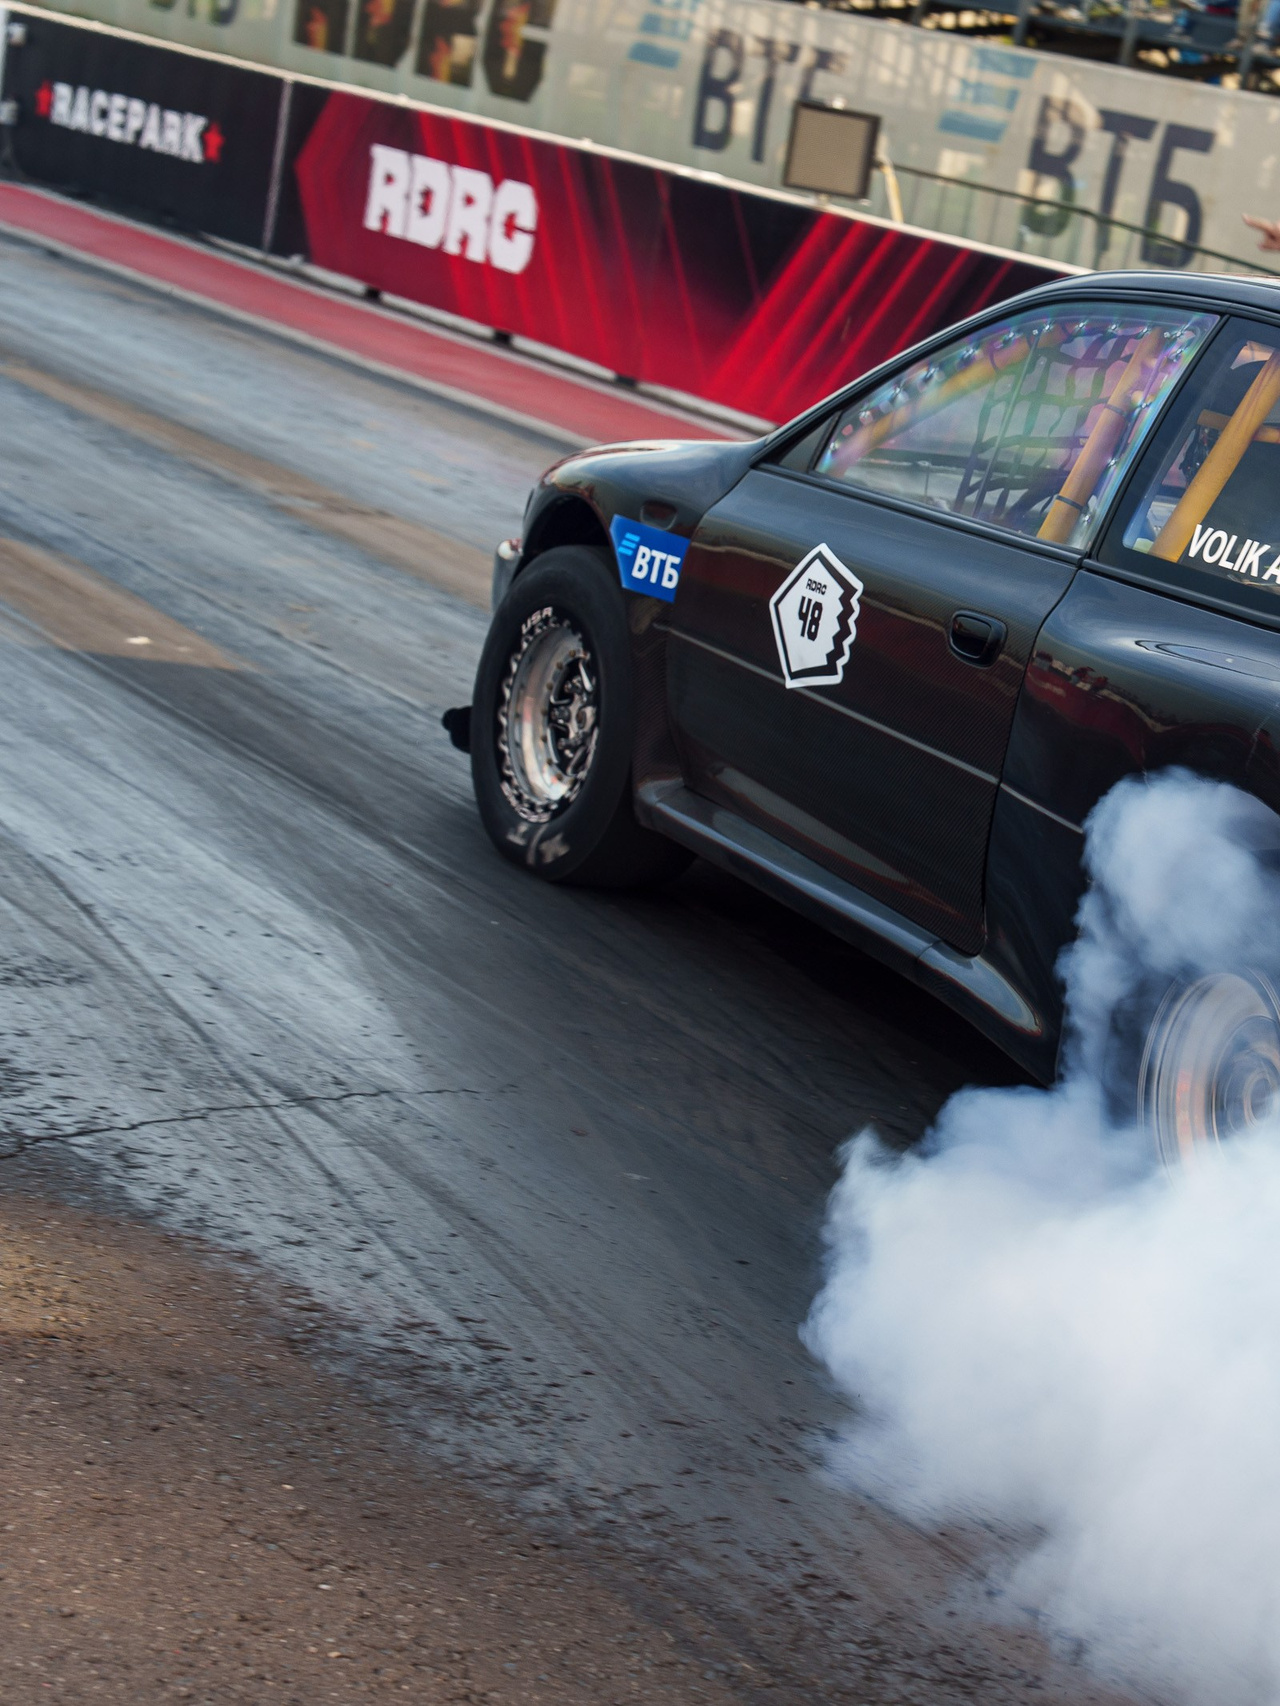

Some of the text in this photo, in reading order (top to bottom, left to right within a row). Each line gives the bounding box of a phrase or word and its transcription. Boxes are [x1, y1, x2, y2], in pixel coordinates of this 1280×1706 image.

[50, 80, 209, 165] RACEPARK
[1023, 94, 1217, 269] ВТБ
[631, 544, 682, 590] ВТБ
[1188, 523, 1272, 578] VOLIK
[521, 606, 553, 634] USA
[798, 595, 824, 642] 48
